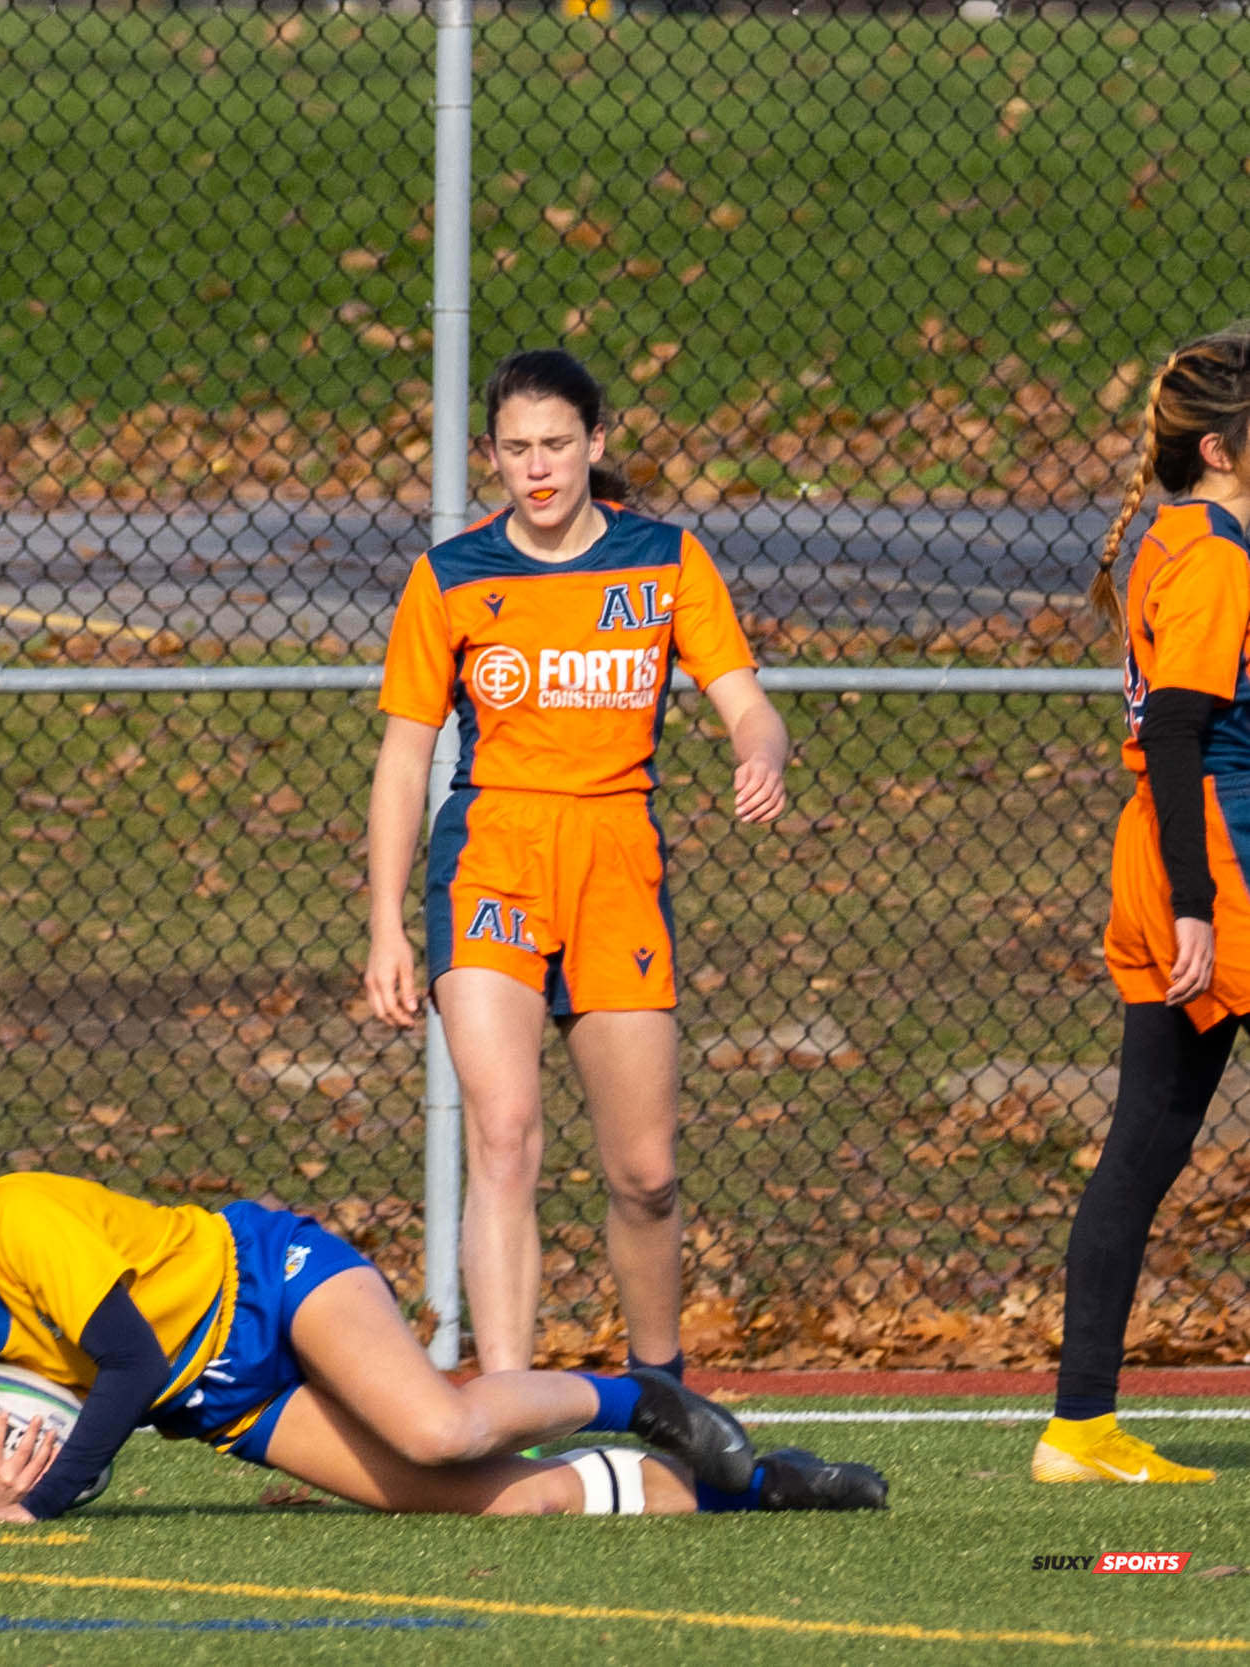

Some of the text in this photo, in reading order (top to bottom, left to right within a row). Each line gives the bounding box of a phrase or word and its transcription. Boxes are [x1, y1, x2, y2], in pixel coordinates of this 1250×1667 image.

[597, 581, 673, 630] AL
[539, 646, 660, 690] FORTIS
[465, 897, 538, 953] AL
